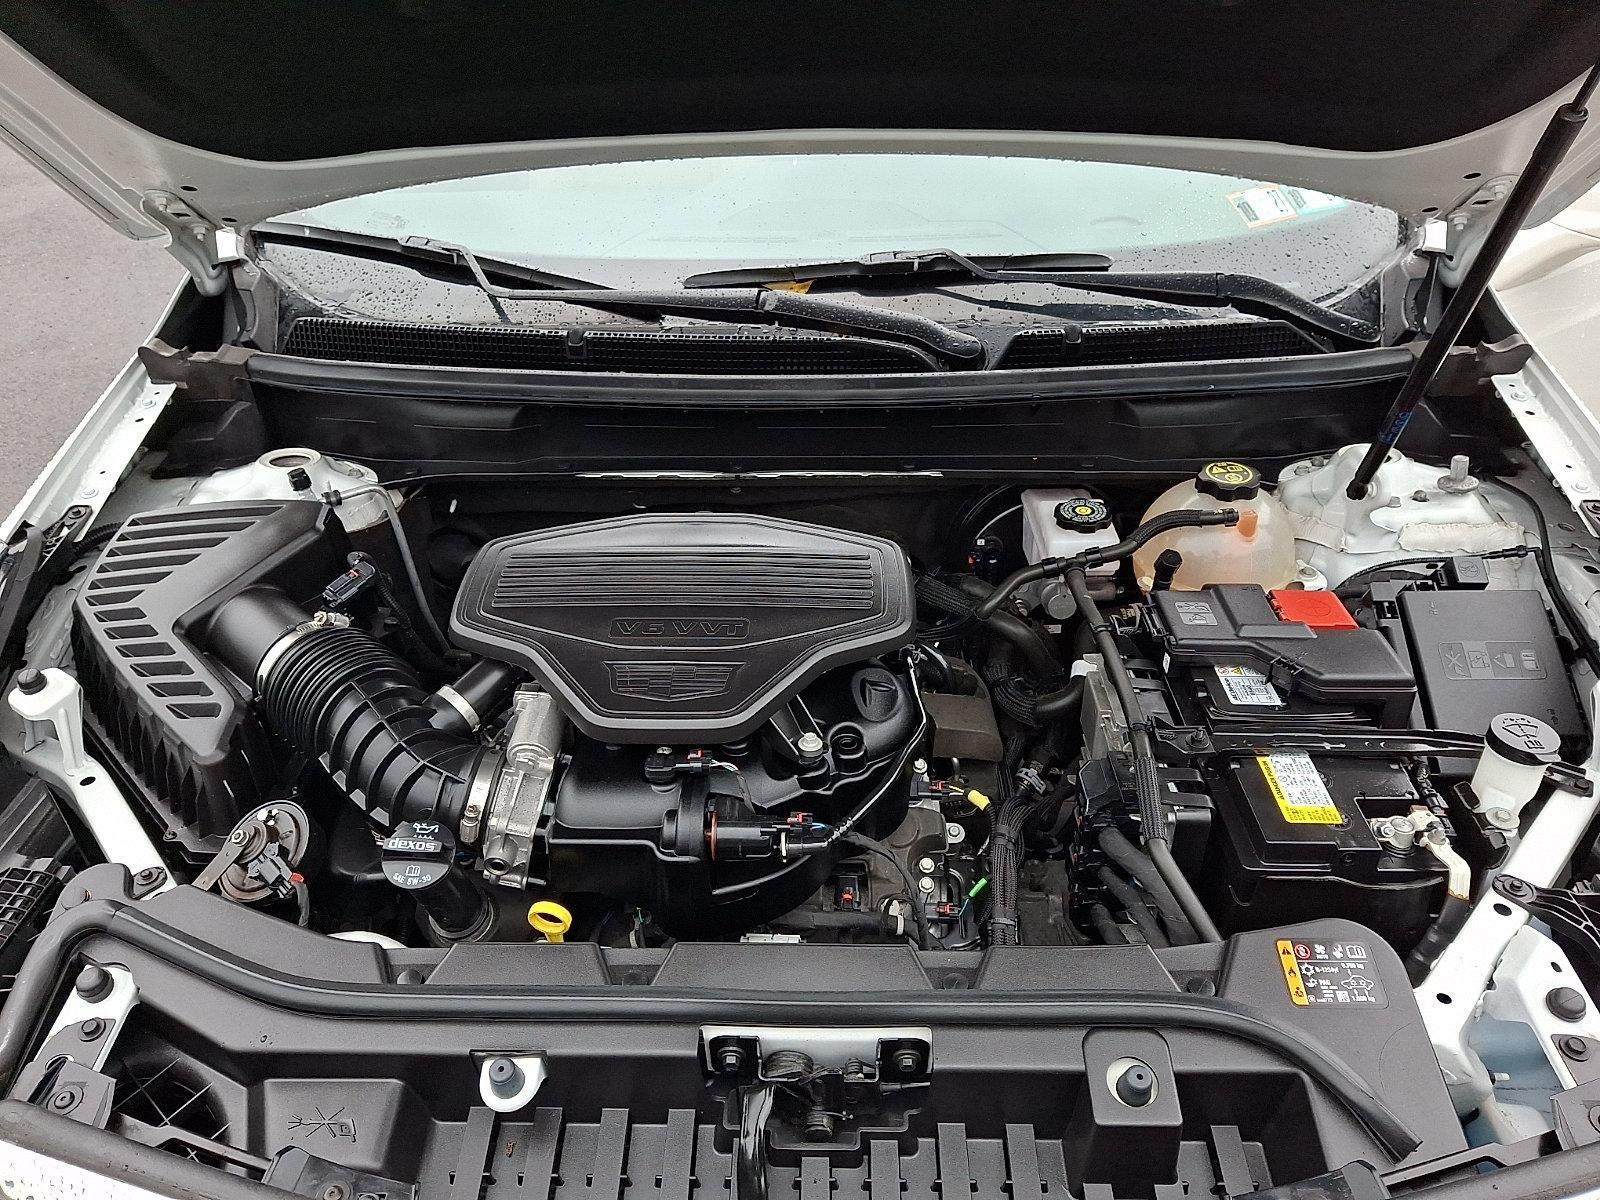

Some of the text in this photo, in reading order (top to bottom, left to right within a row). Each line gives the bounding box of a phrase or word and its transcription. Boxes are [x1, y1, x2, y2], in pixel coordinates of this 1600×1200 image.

[672, 621, 744, 636] VVT
[388, 838, 437, 851] dexos
[393, 873, 432, 885] SAE 5W-30
